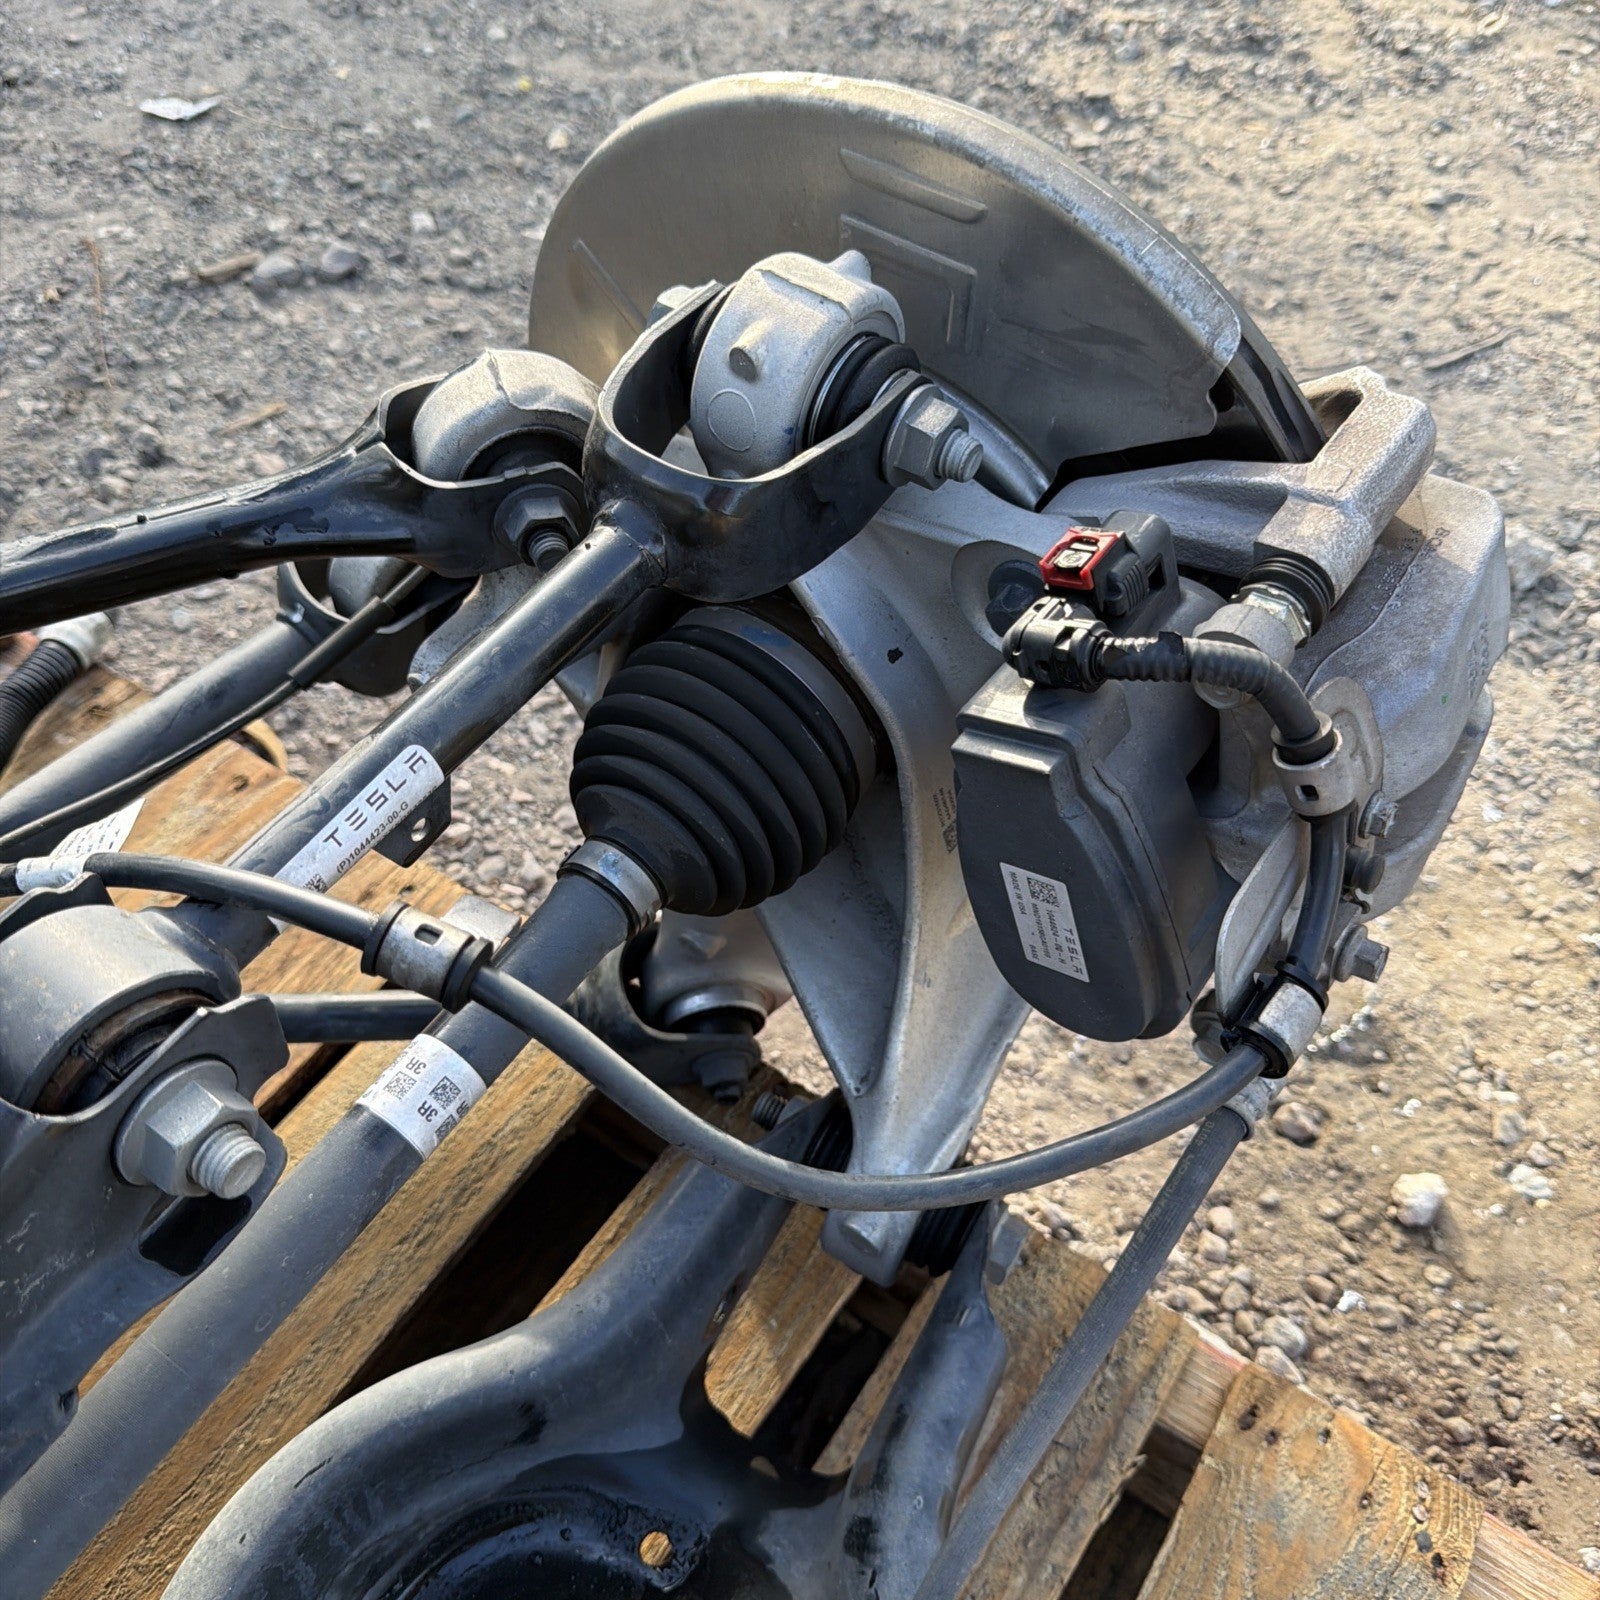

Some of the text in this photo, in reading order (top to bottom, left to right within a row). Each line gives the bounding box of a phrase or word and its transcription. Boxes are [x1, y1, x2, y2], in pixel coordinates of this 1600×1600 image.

[323, 751, 427, 848] TESLA
[336, 801, 409, 874] (P)1044423-00-G
[1063, 928, 1083, 975] TESLA
[406, 1057, 427, 1075] 3R
[417, 1100, 438, 1123] 3R
